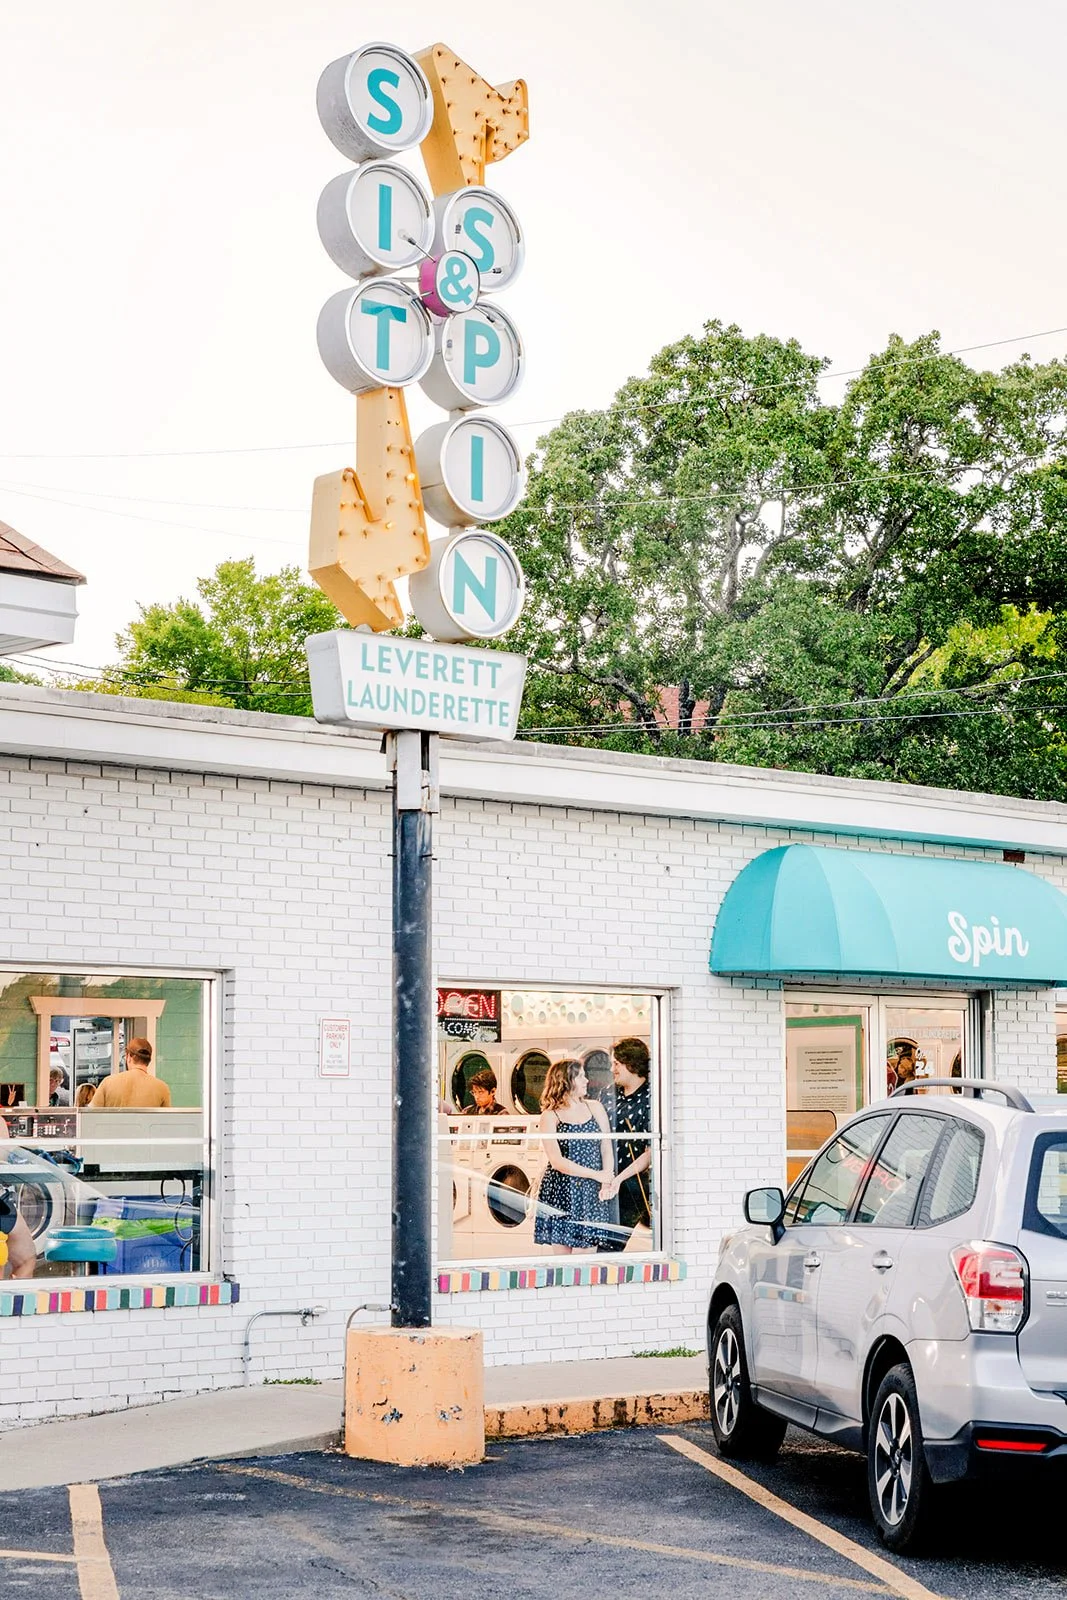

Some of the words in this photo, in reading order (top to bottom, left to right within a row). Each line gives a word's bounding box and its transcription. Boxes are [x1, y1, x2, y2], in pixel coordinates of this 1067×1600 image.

[361, 67, 408, 372] SIT
[439, 256, 473, 306] &
[452, 206, 502, 623] SPIN
[361, 641, 503, 690] LEVERETT
[347, 679, 511, 728] LAUNDERETTE
[947, 910, 1030, 968] Spin
[323, 1023, 349, 1032] CUSTOMER
[326, 1032, 346, 1041] PARKING
[329, 1041, 342, 1049] ONLY
